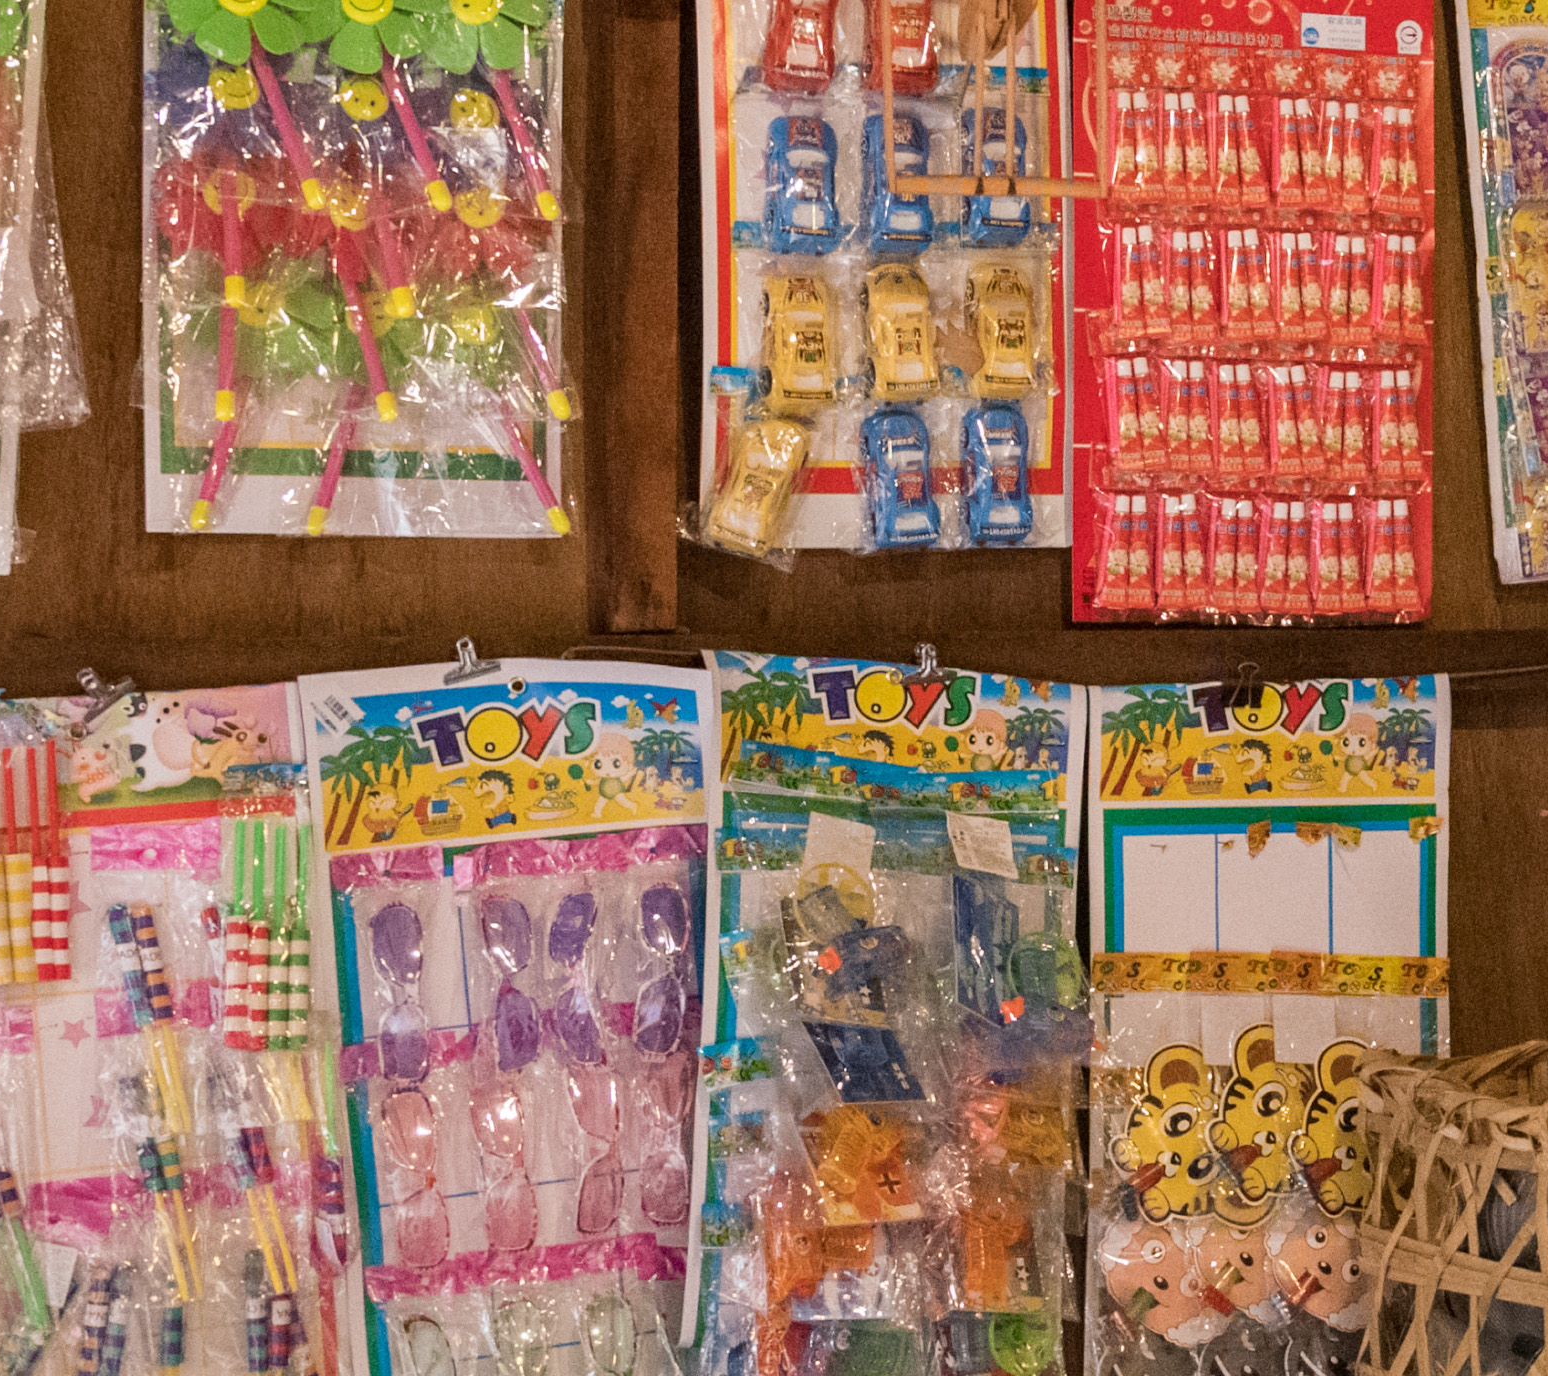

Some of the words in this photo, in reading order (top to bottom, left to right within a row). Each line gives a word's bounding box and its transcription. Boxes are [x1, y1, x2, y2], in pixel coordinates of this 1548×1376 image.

[812, 669, 977, 728] TOYS
[1192, 682, 1349, 734] TOYS
[416, 701, 597, 767] TOYS
